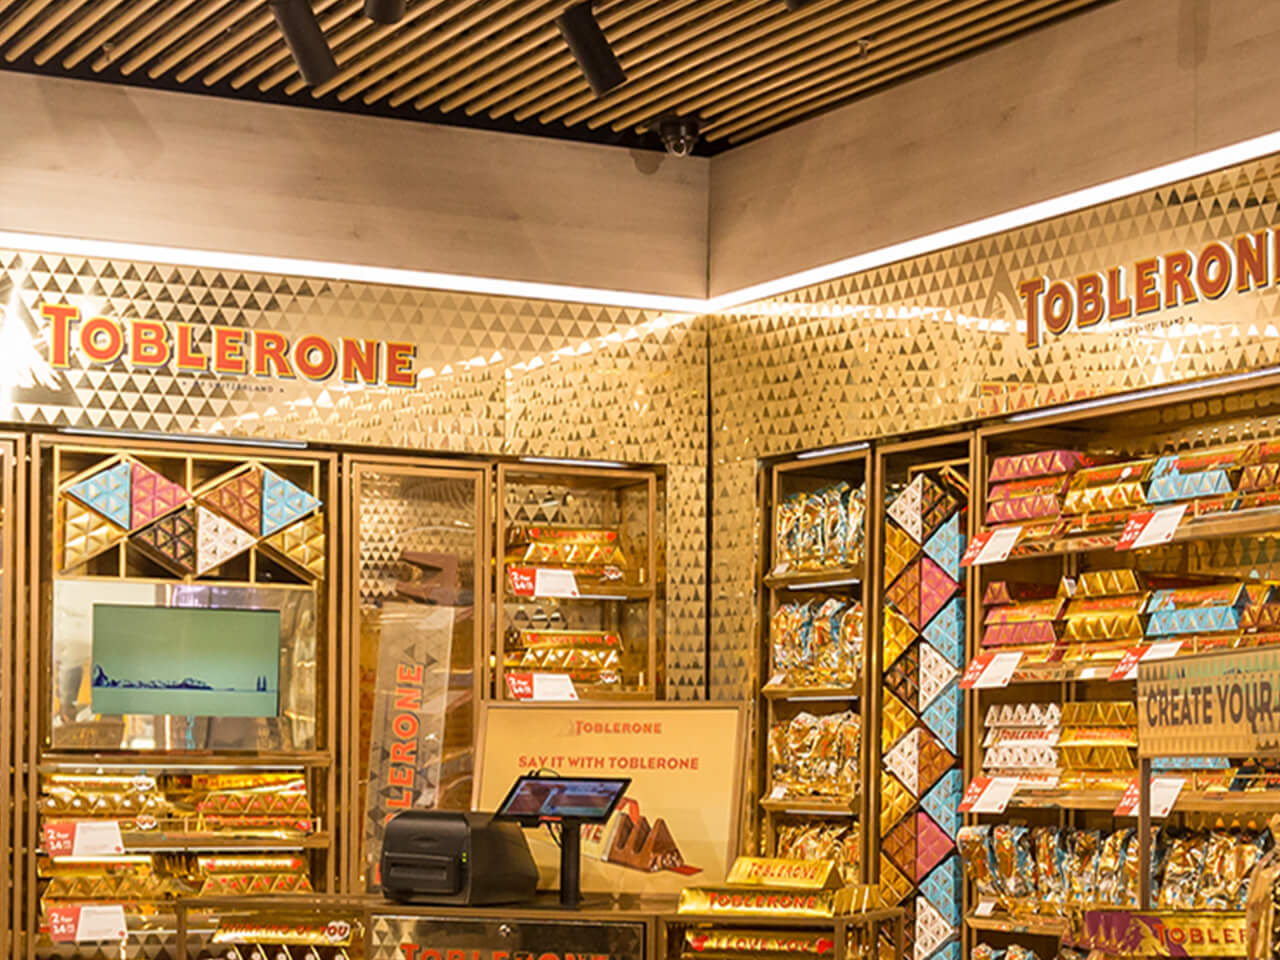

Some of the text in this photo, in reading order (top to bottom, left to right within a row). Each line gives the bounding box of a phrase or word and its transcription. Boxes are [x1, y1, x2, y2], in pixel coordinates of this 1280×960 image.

[40, 302, 418, 388] TOBLERONE
[1146, 686, 1213, 727] CREATE
[1217, 680, 1273, 724] YOUR
[576, 720, 662, 736] TOBLERONE
[519, 756, 699, 770] SAY IT WITH TOBLERONE
[709, 892, 818, 909] TOBLERONE
[319, 925, 349, 937] YOU
